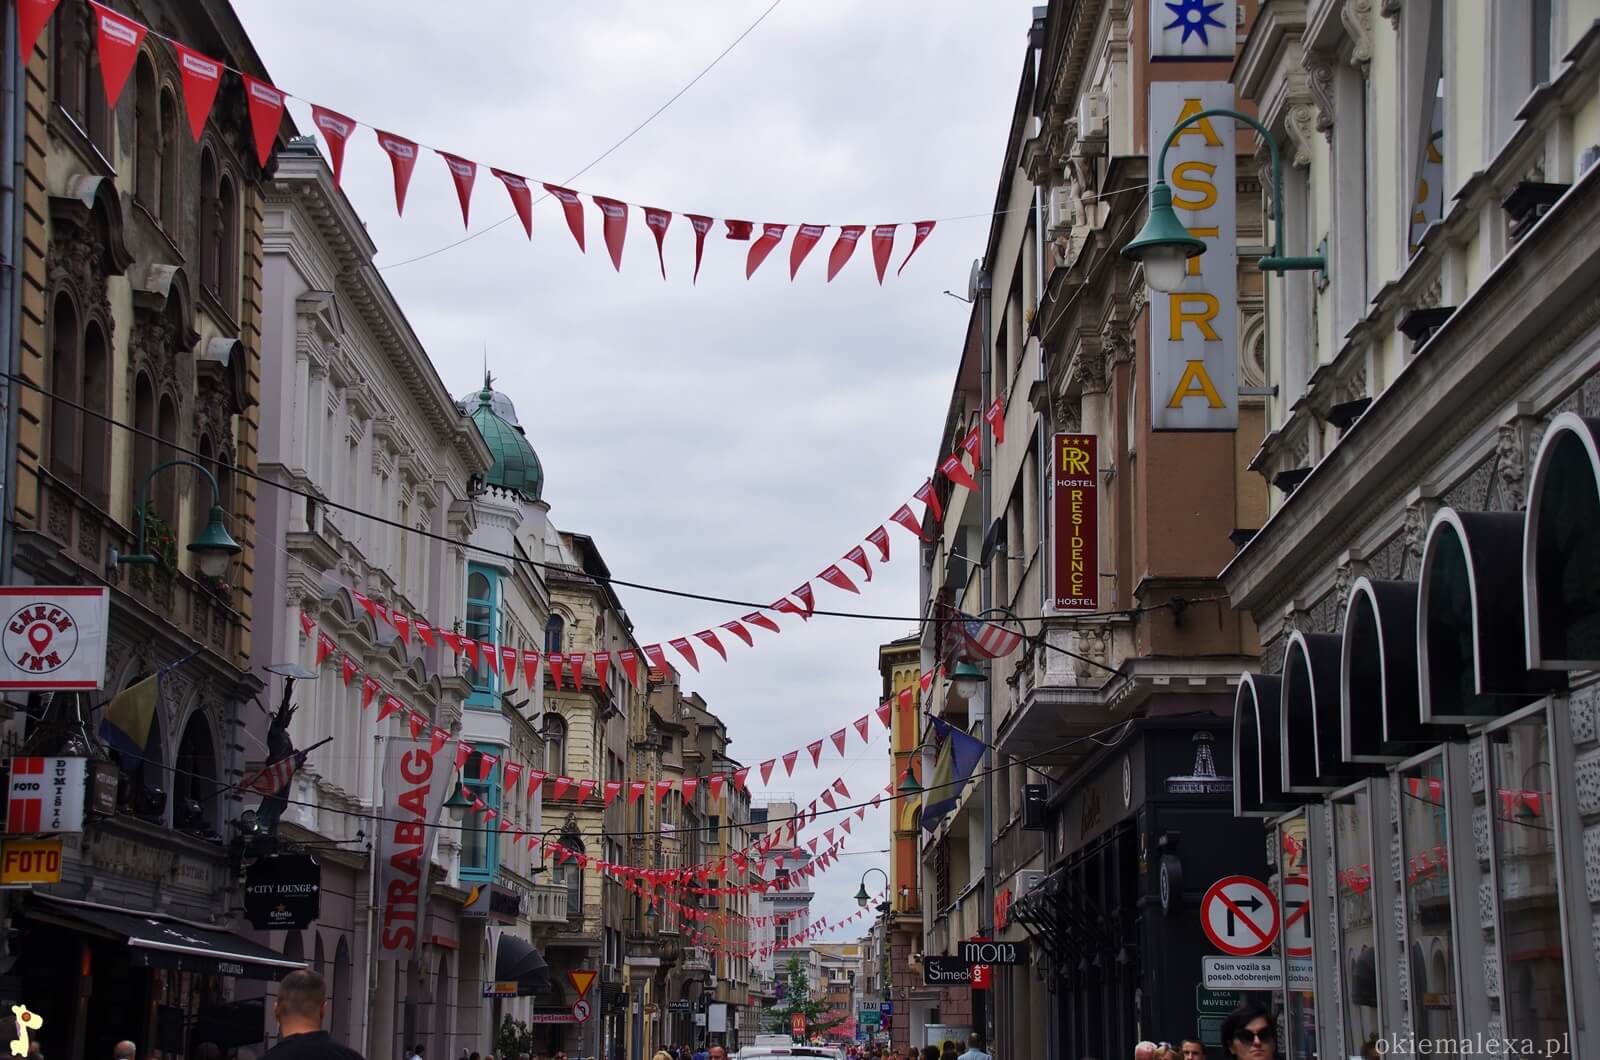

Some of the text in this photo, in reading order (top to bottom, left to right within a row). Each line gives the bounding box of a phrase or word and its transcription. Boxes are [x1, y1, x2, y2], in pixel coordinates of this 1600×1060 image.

[1166, 98, 1226, 409] ASTRA
[1057, 479, 1096, 487] HOSTEL
[1071, 490, 1084, 596] RESIDENCE
[1057, 598, 1097, 606] HOSTEL
[9, 606, 73, 634] CHECK
[17, 650, 62, 671] INN
[14, 783, 40, 791] FOTO
[383, 748, 433, 951] STRABAG
[5, 850, 59, 873] FOTO
[254, 884, 312, 893] CITY LOUNGE
[929, 961, 972, 980] Šimeck
[1213, 963, 1235, 971] Osim
[1236, 963, 1260, 971] vozila
